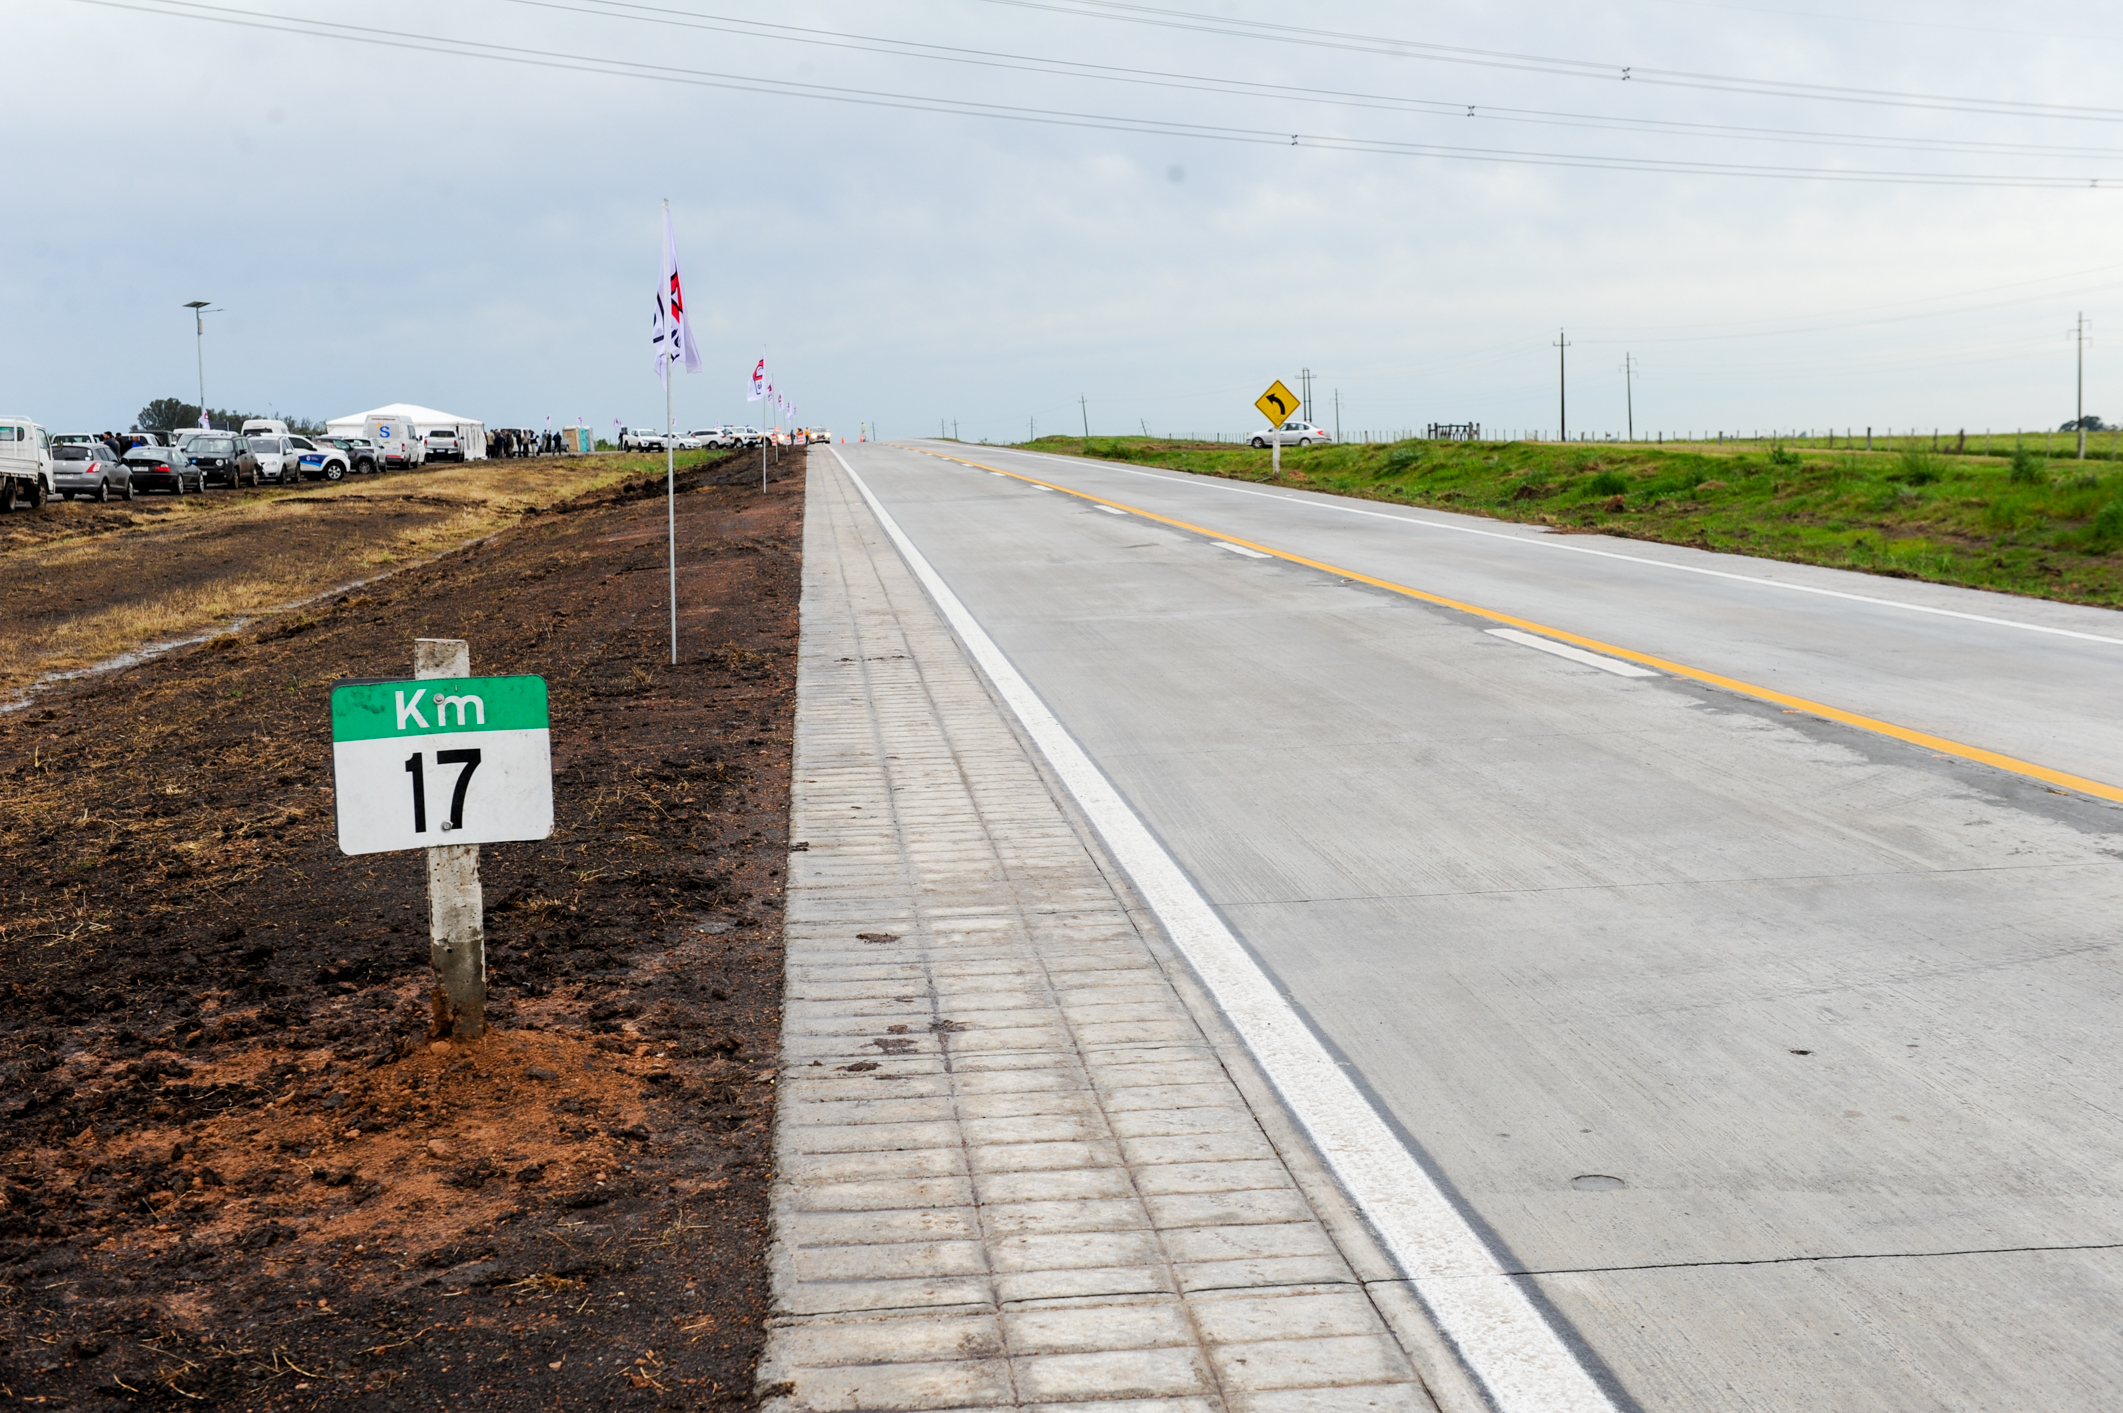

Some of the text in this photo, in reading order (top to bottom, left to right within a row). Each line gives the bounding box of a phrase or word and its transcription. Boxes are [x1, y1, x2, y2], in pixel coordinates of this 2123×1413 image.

[379, 426, 391, 438] S
[395, 689, 485, 730] Km
[405, 748, 481, 833] 17
